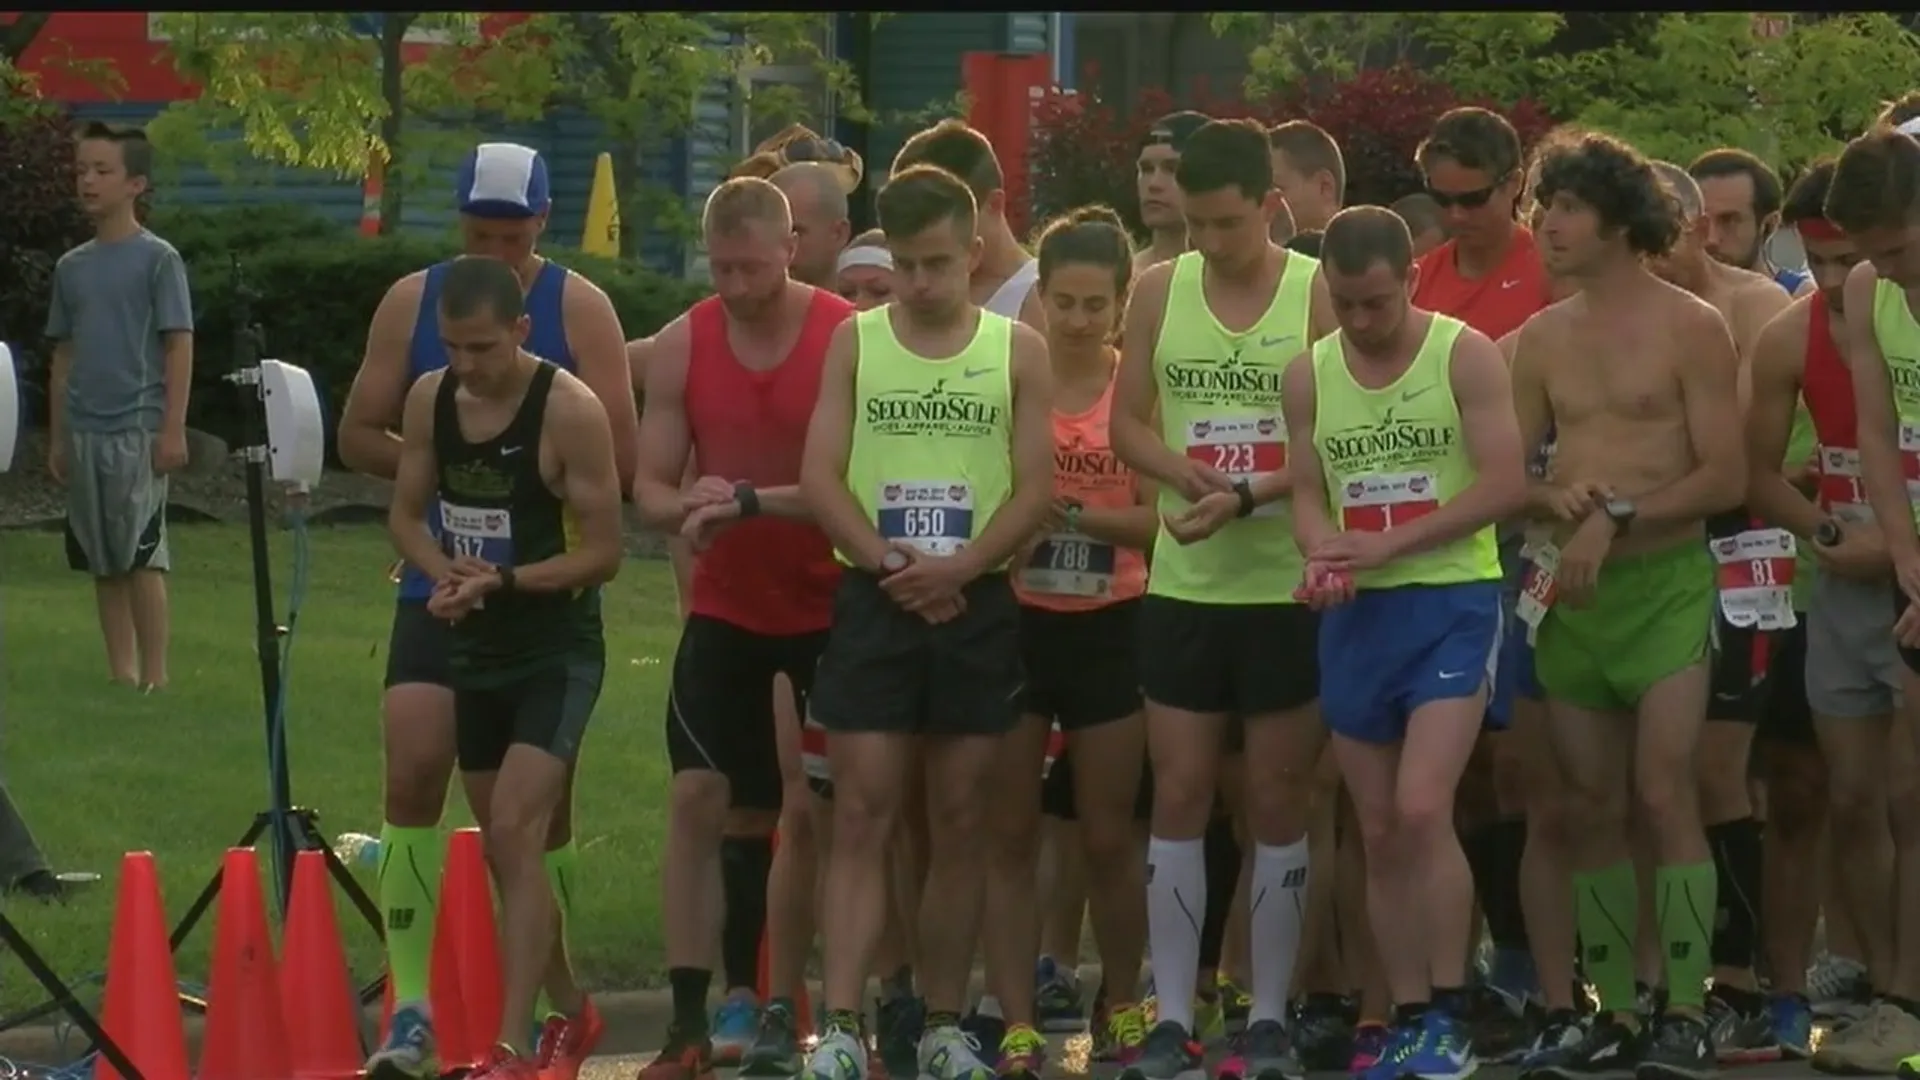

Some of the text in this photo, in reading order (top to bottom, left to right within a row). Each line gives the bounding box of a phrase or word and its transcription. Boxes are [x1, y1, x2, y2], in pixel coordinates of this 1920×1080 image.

[1165, 363, 1281, 392] SECONDSOL
[866, 397, 1000, 425] SECONDSOLE
[1325, 425, 1455, 462] SECONDSOLE
[1214, 444, 1254, 472] 223
[904, 508, 945, 536] 650
[1381, 504, 1392, 532] 1
[1049, 542, 1090, 571] 788
[1528, 569, 1554, 601] 59
[1751, 558, 1776, 586] 81
